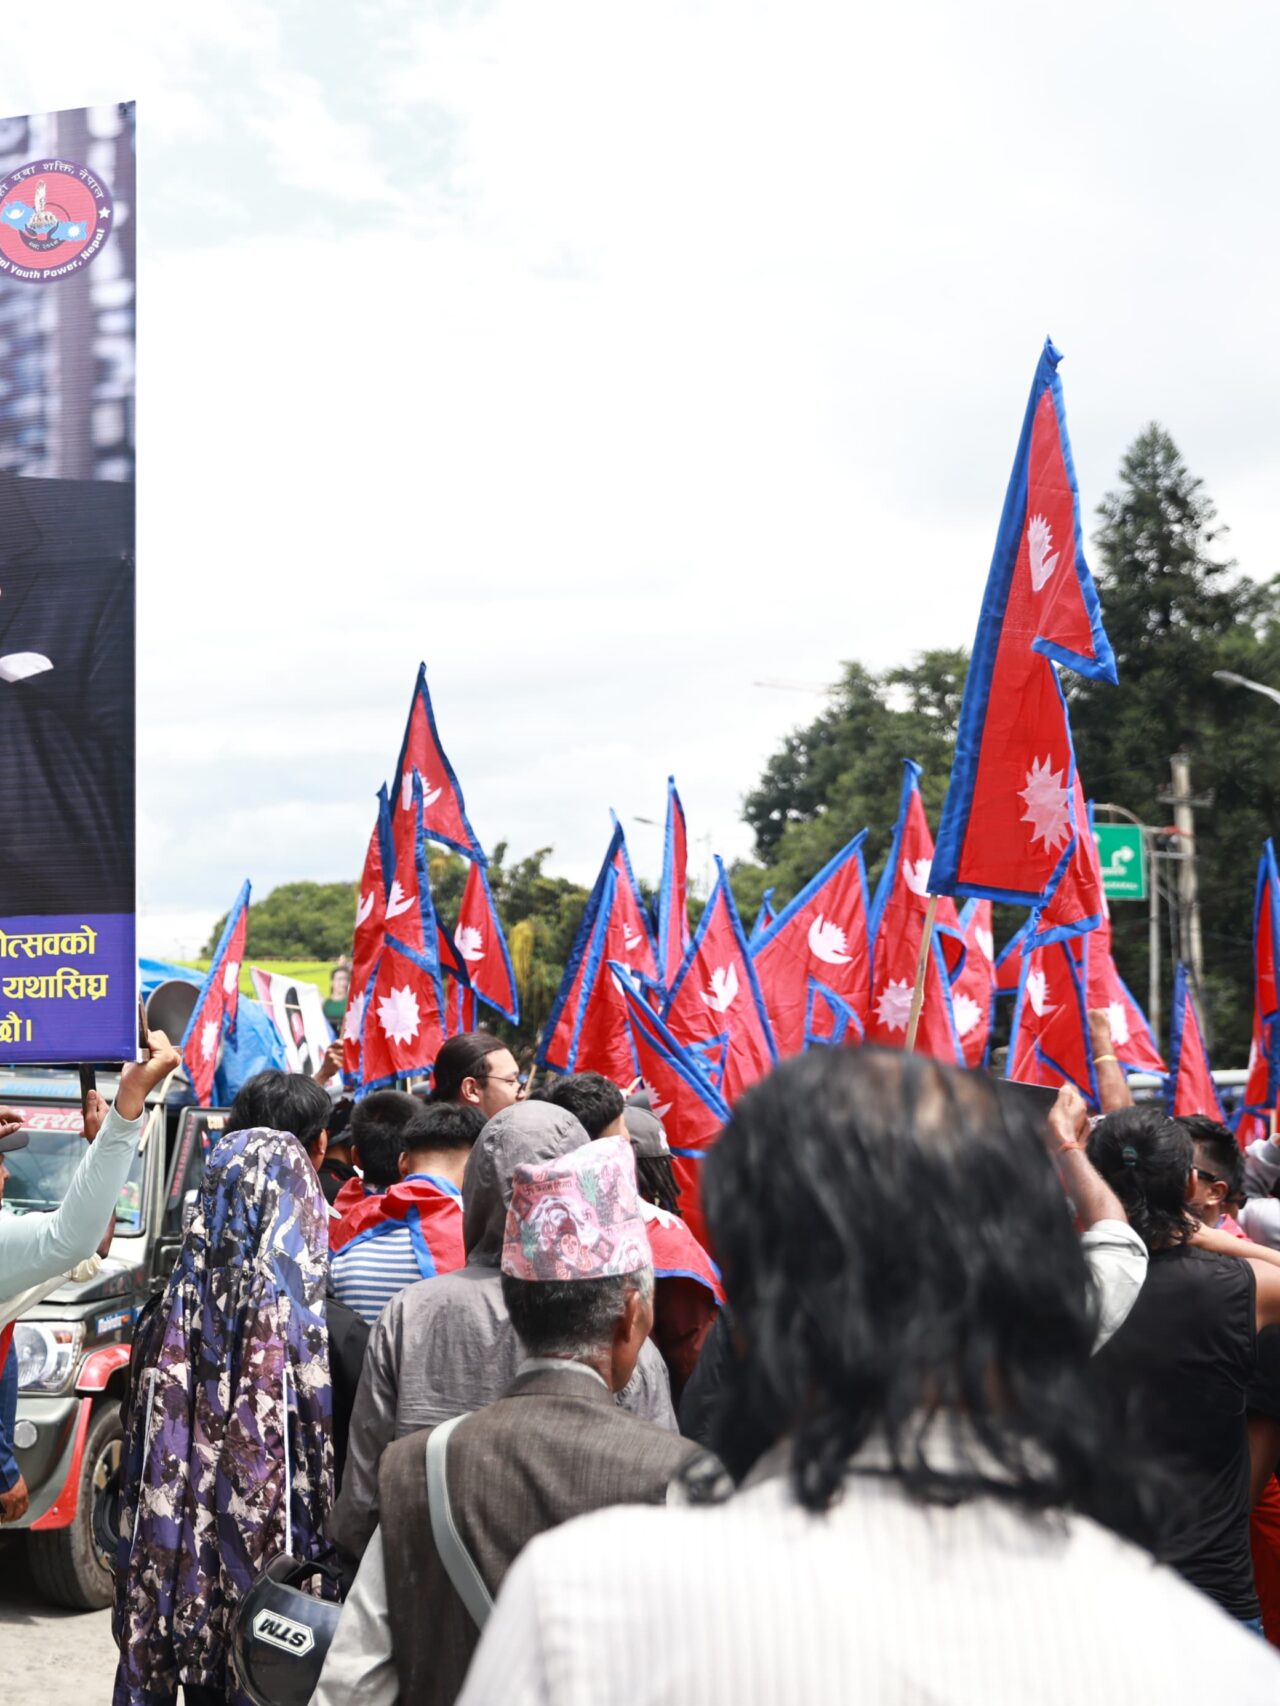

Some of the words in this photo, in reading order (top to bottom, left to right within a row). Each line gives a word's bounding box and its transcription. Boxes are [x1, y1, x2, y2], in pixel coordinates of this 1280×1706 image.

[9, 264, 41, 279] Youth
[43, 258, 83, 279] Power,
[80, 228, 106, 260] Nepal
[2, 966, 109, 1001] यथासिघ्र
[258, 1618, 307, 1648] STM
